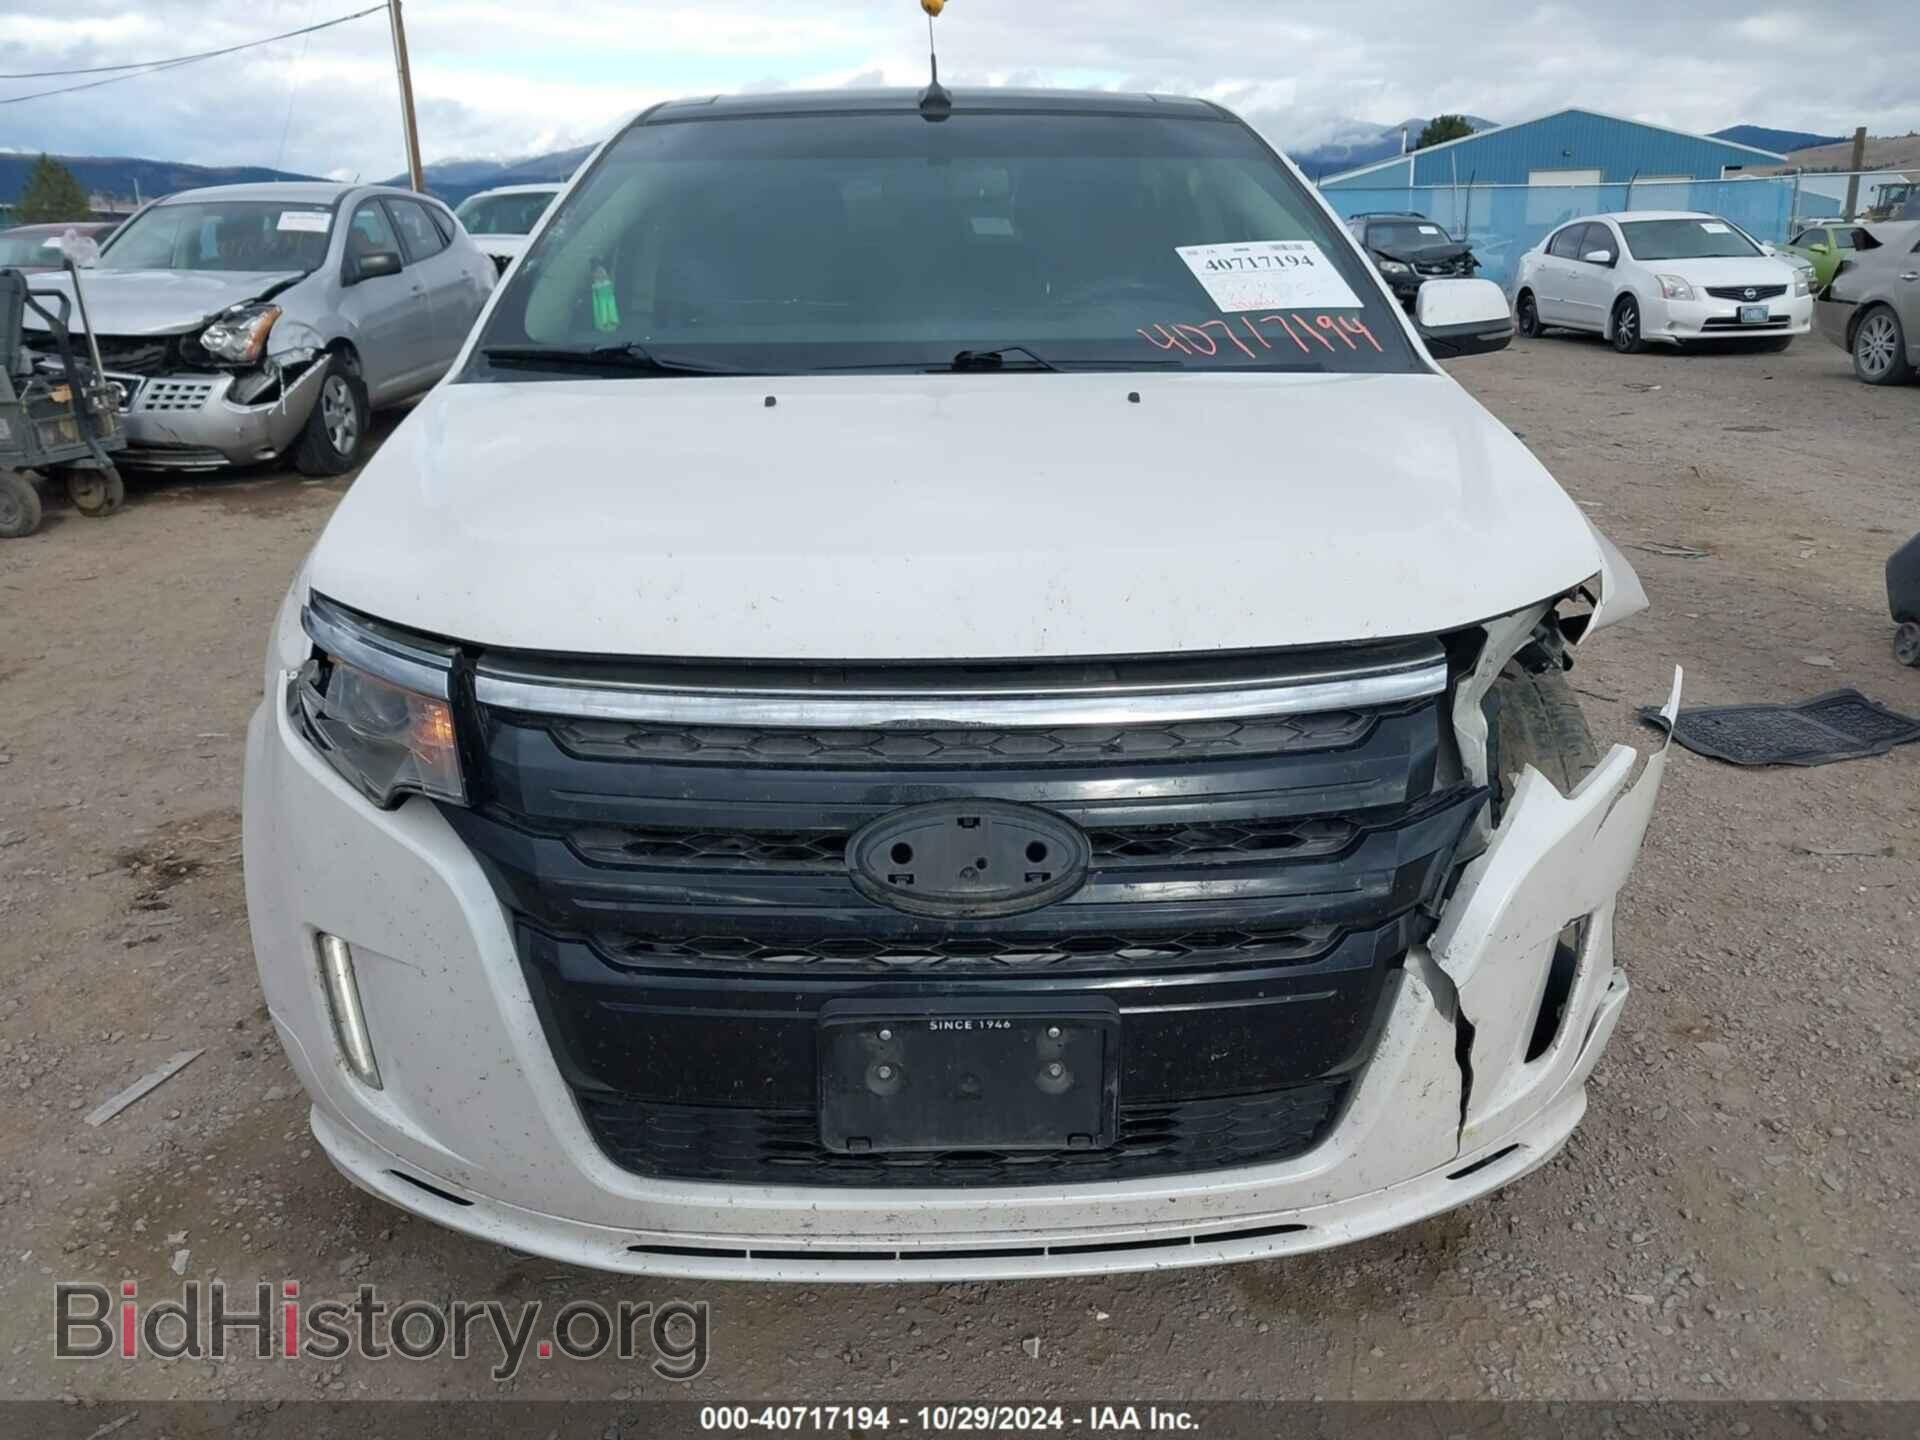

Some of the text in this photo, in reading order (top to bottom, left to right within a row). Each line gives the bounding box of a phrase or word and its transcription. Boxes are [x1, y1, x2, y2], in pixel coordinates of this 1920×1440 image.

[1204, 254, 1315, 272] 40717194
[1136, 312, 1384, 359] 40717194
[929, 1019, 1011, 1031] SINCE 1946
